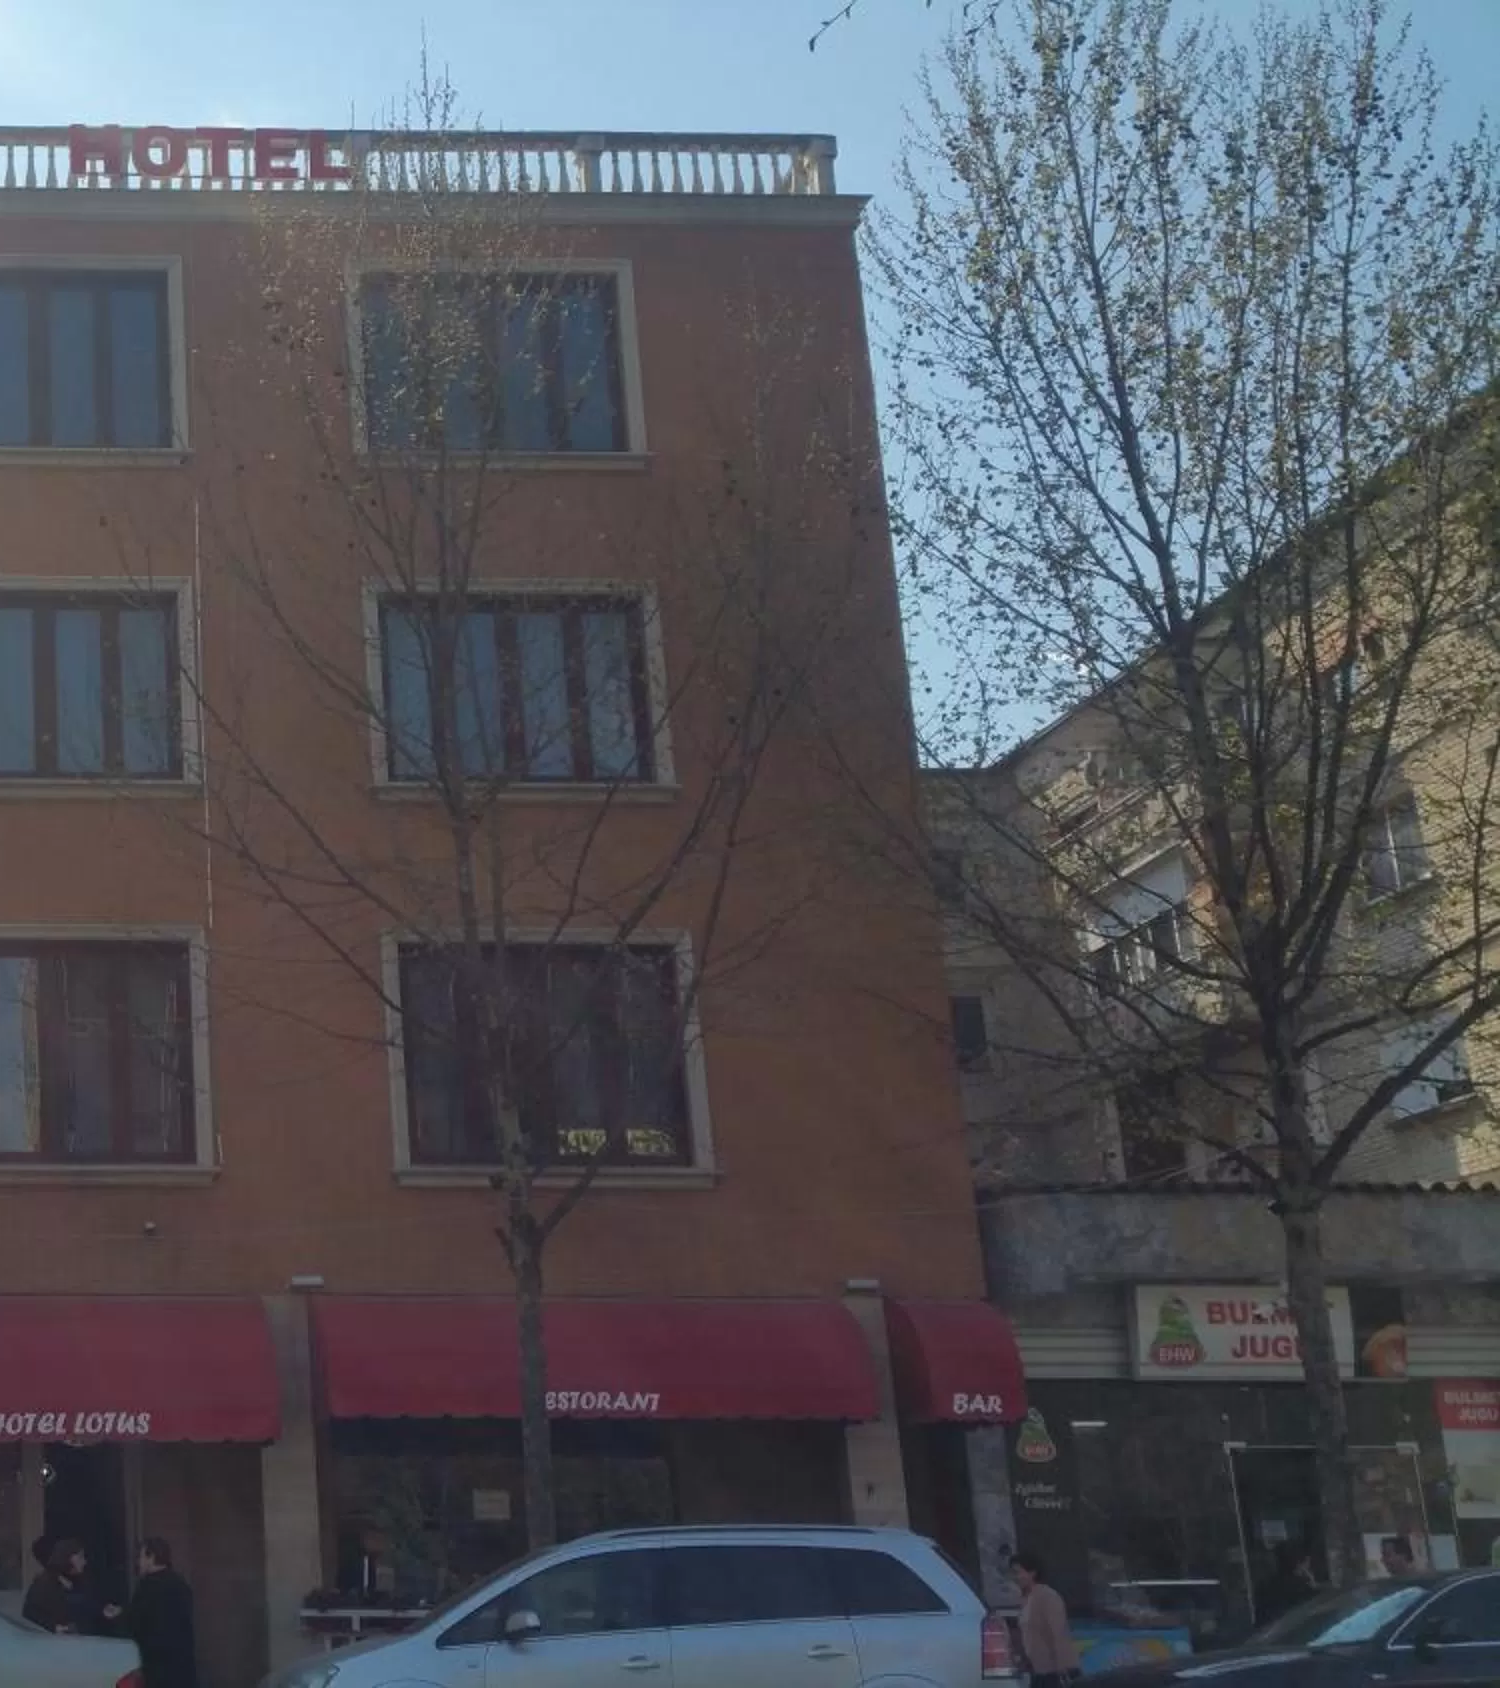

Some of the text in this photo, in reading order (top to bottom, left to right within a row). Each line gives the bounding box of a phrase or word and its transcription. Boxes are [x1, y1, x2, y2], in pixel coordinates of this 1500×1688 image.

[67, 123, 355, 179] HOTEL
[1231, 1335, 1301, 1360] JUG
[544, 1391, 661, 1411] ESTORANT
[952, 1392, 1004, 1415] BAR
[72, 1411, 151, 1435] LOTUS
